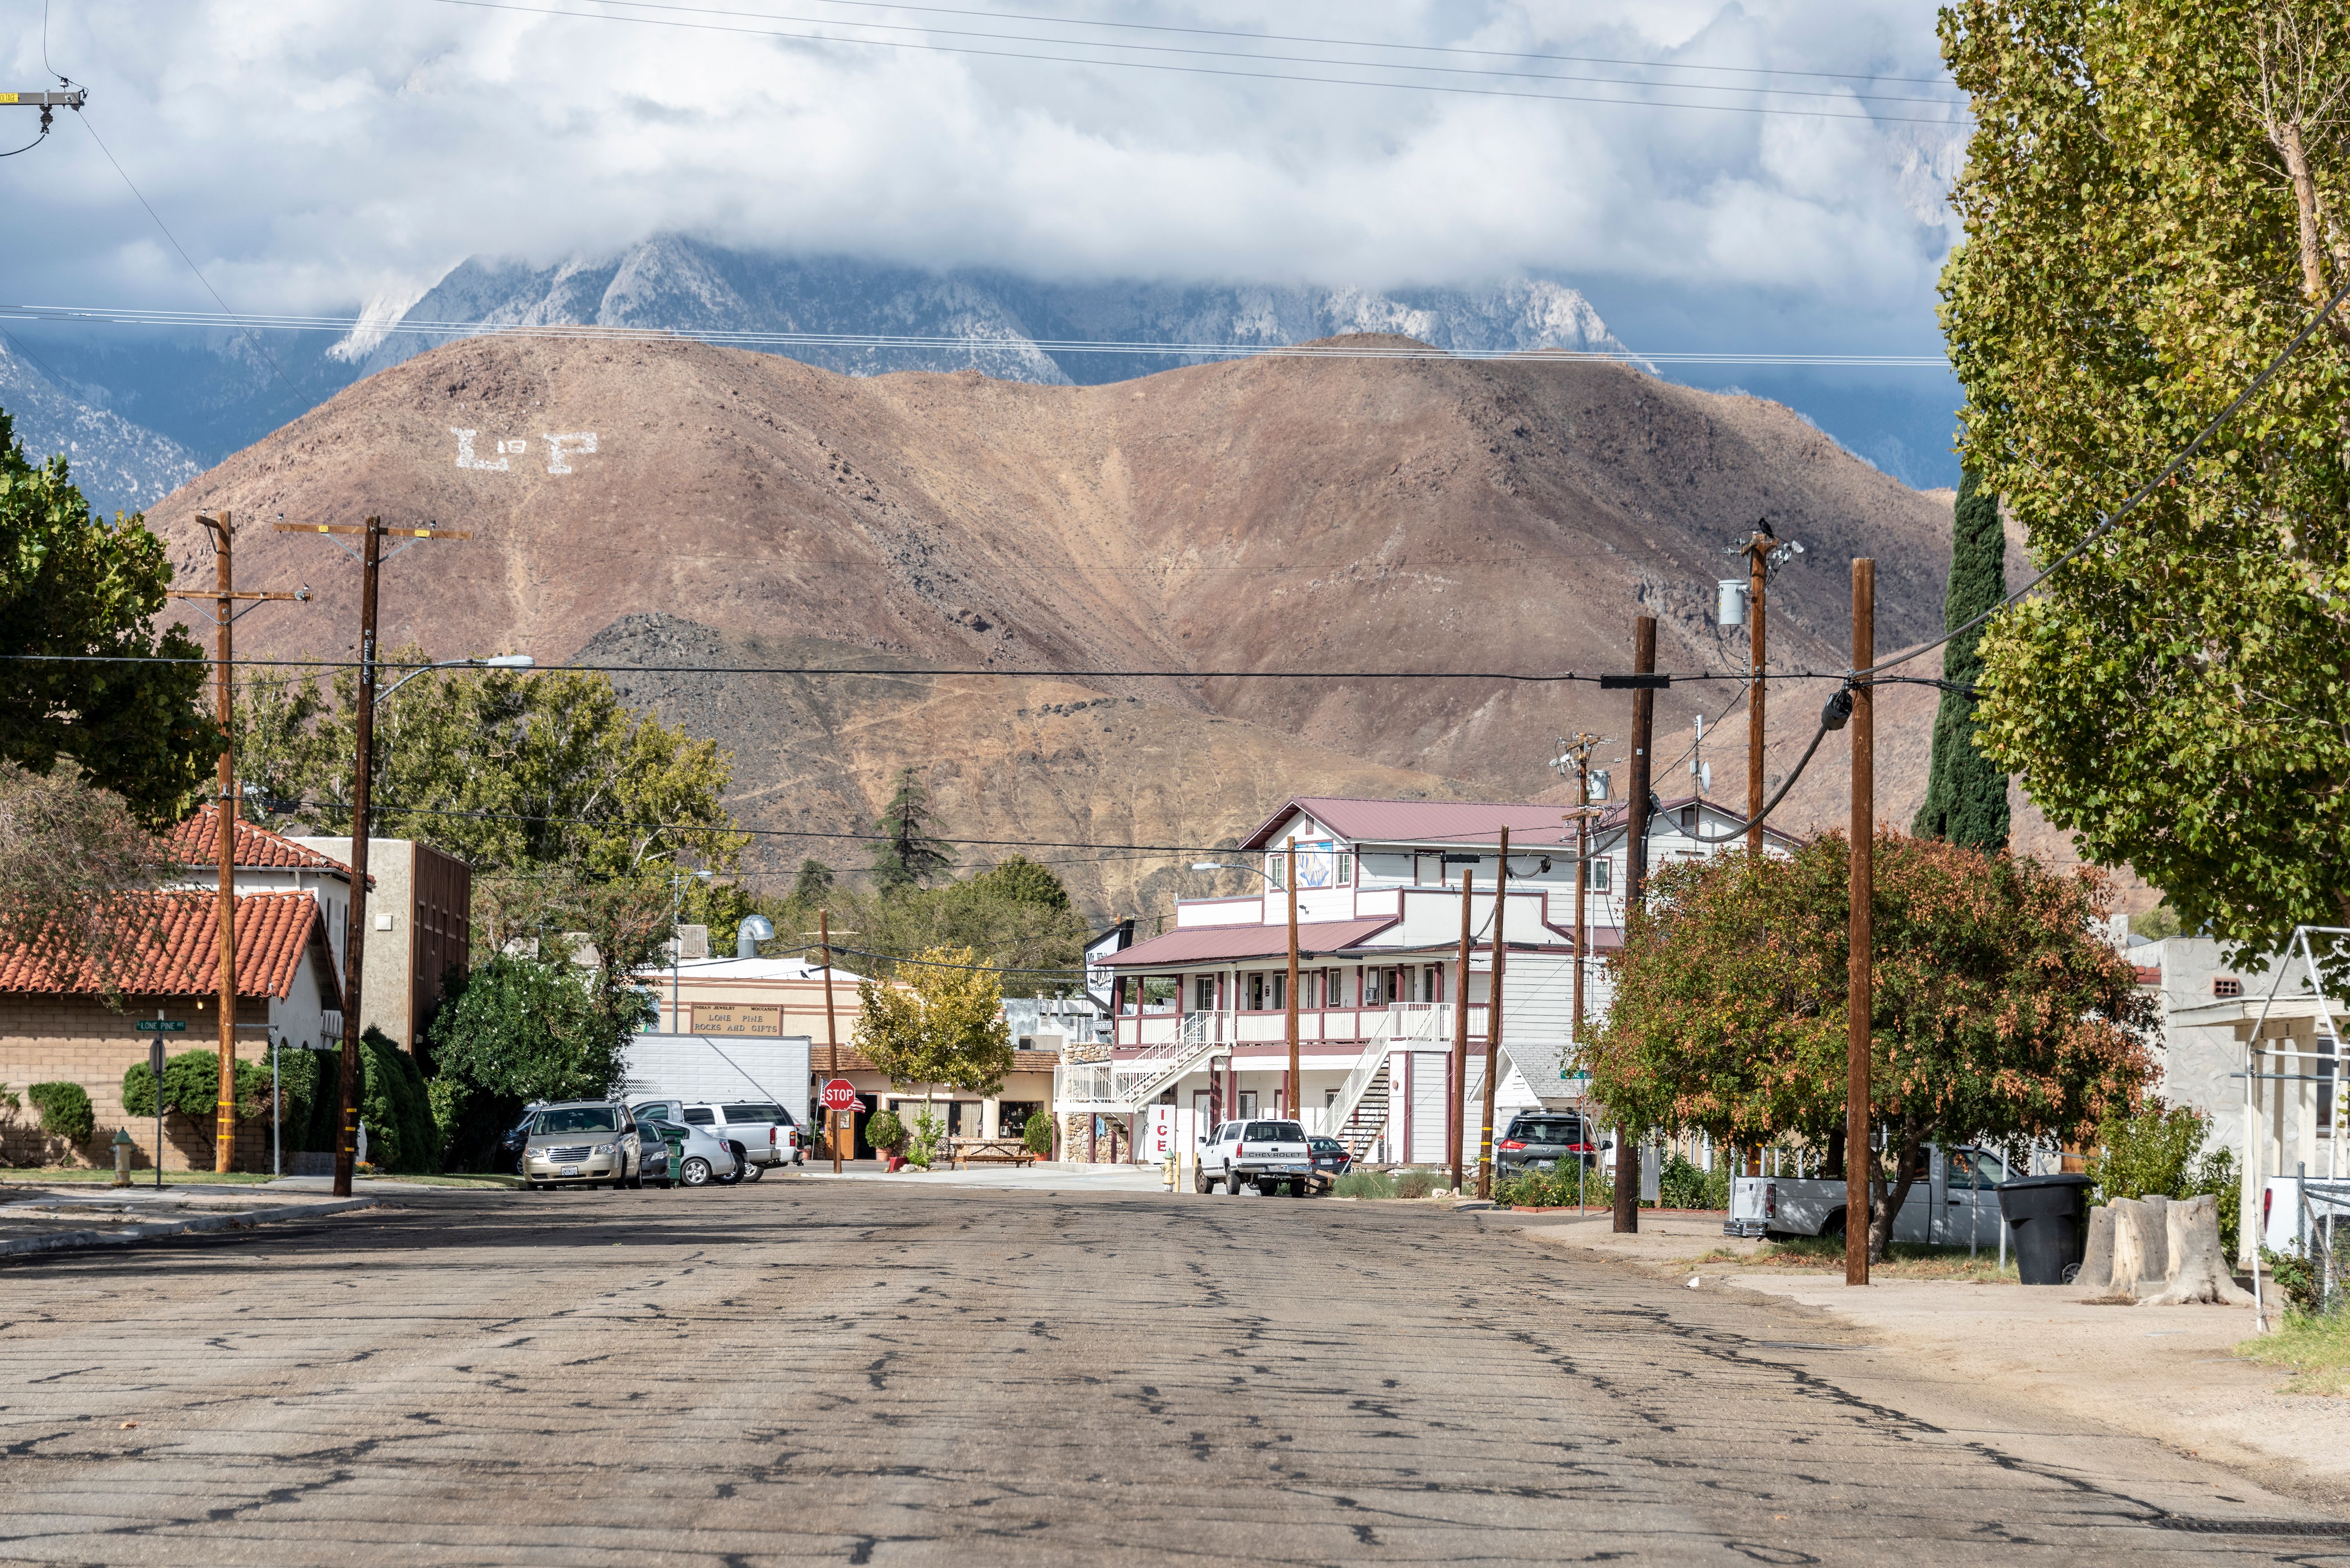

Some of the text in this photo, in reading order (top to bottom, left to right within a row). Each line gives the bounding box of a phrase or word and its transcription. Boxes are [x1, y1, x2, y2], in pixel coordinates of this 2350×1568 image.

[544, 431, 597, 473] P
[826, 1089, 853, 1101] STOP
[1157, 1109, 1167, 1152] ICE
